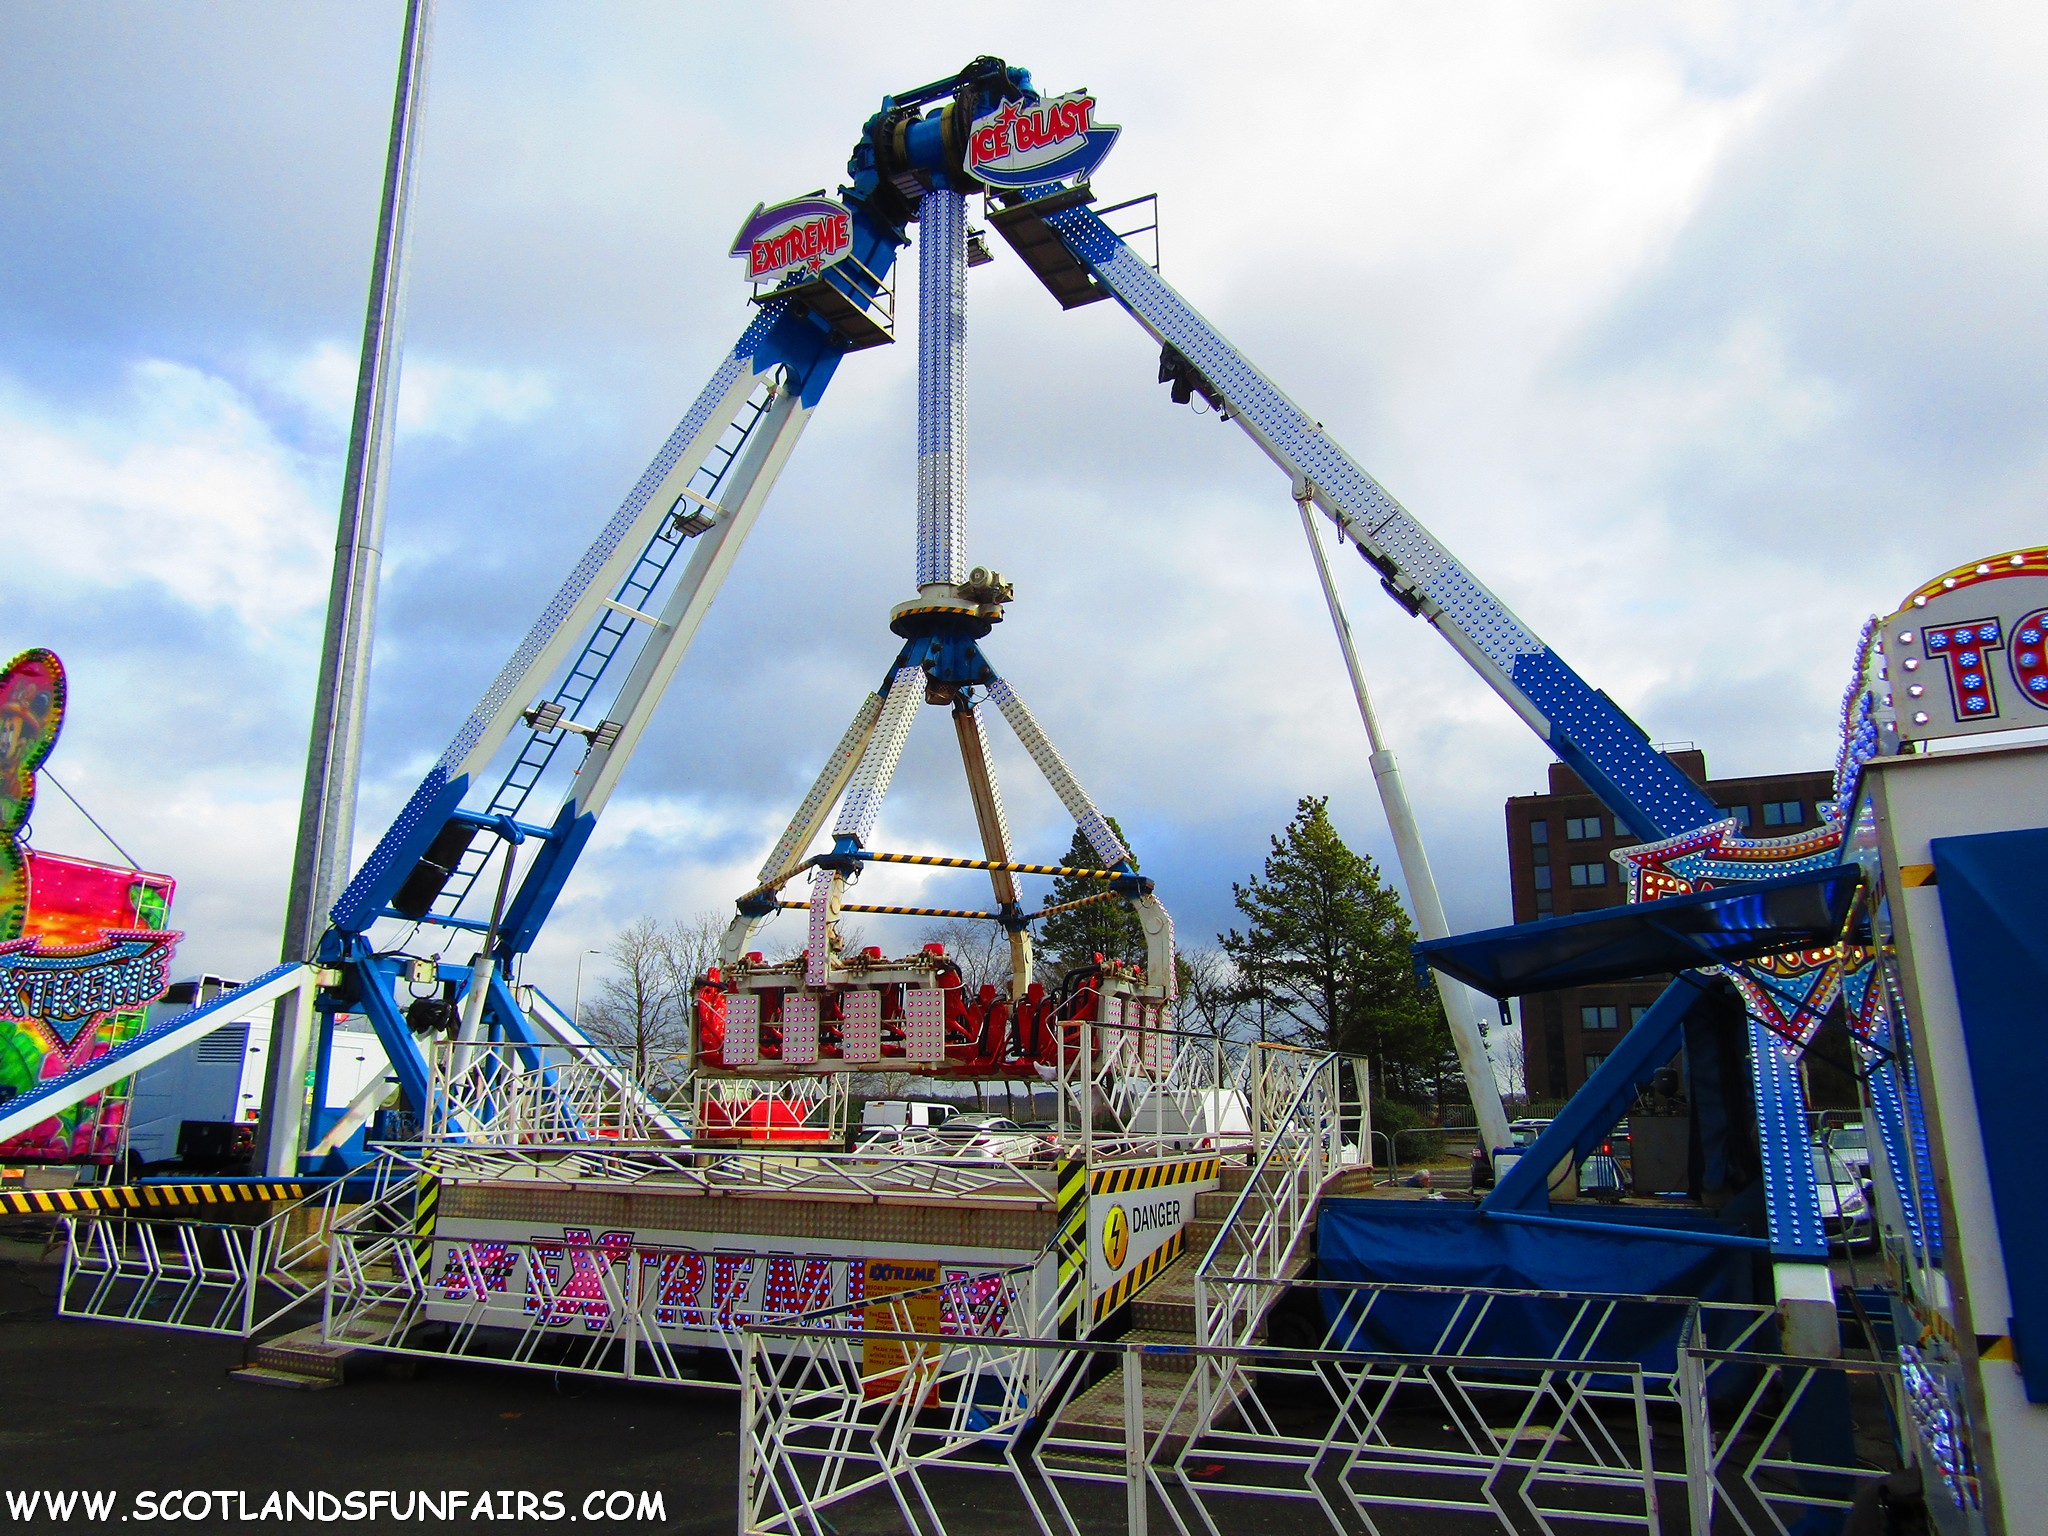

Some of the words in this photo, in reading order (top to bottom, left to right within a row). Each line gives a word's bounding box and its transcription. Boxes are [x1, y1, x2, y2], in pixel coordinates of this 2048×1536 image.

[970, 123, 1011, 167] ICE
[1014, 98, 1095, 152] BLAST
[750, 213, 850, 277] EXTREME
[0, 945, 169, 1018] XTREME
[1133, 1200, 1180, 1233] DANGER
[869, 1263, 936, 1282] EXTREME
